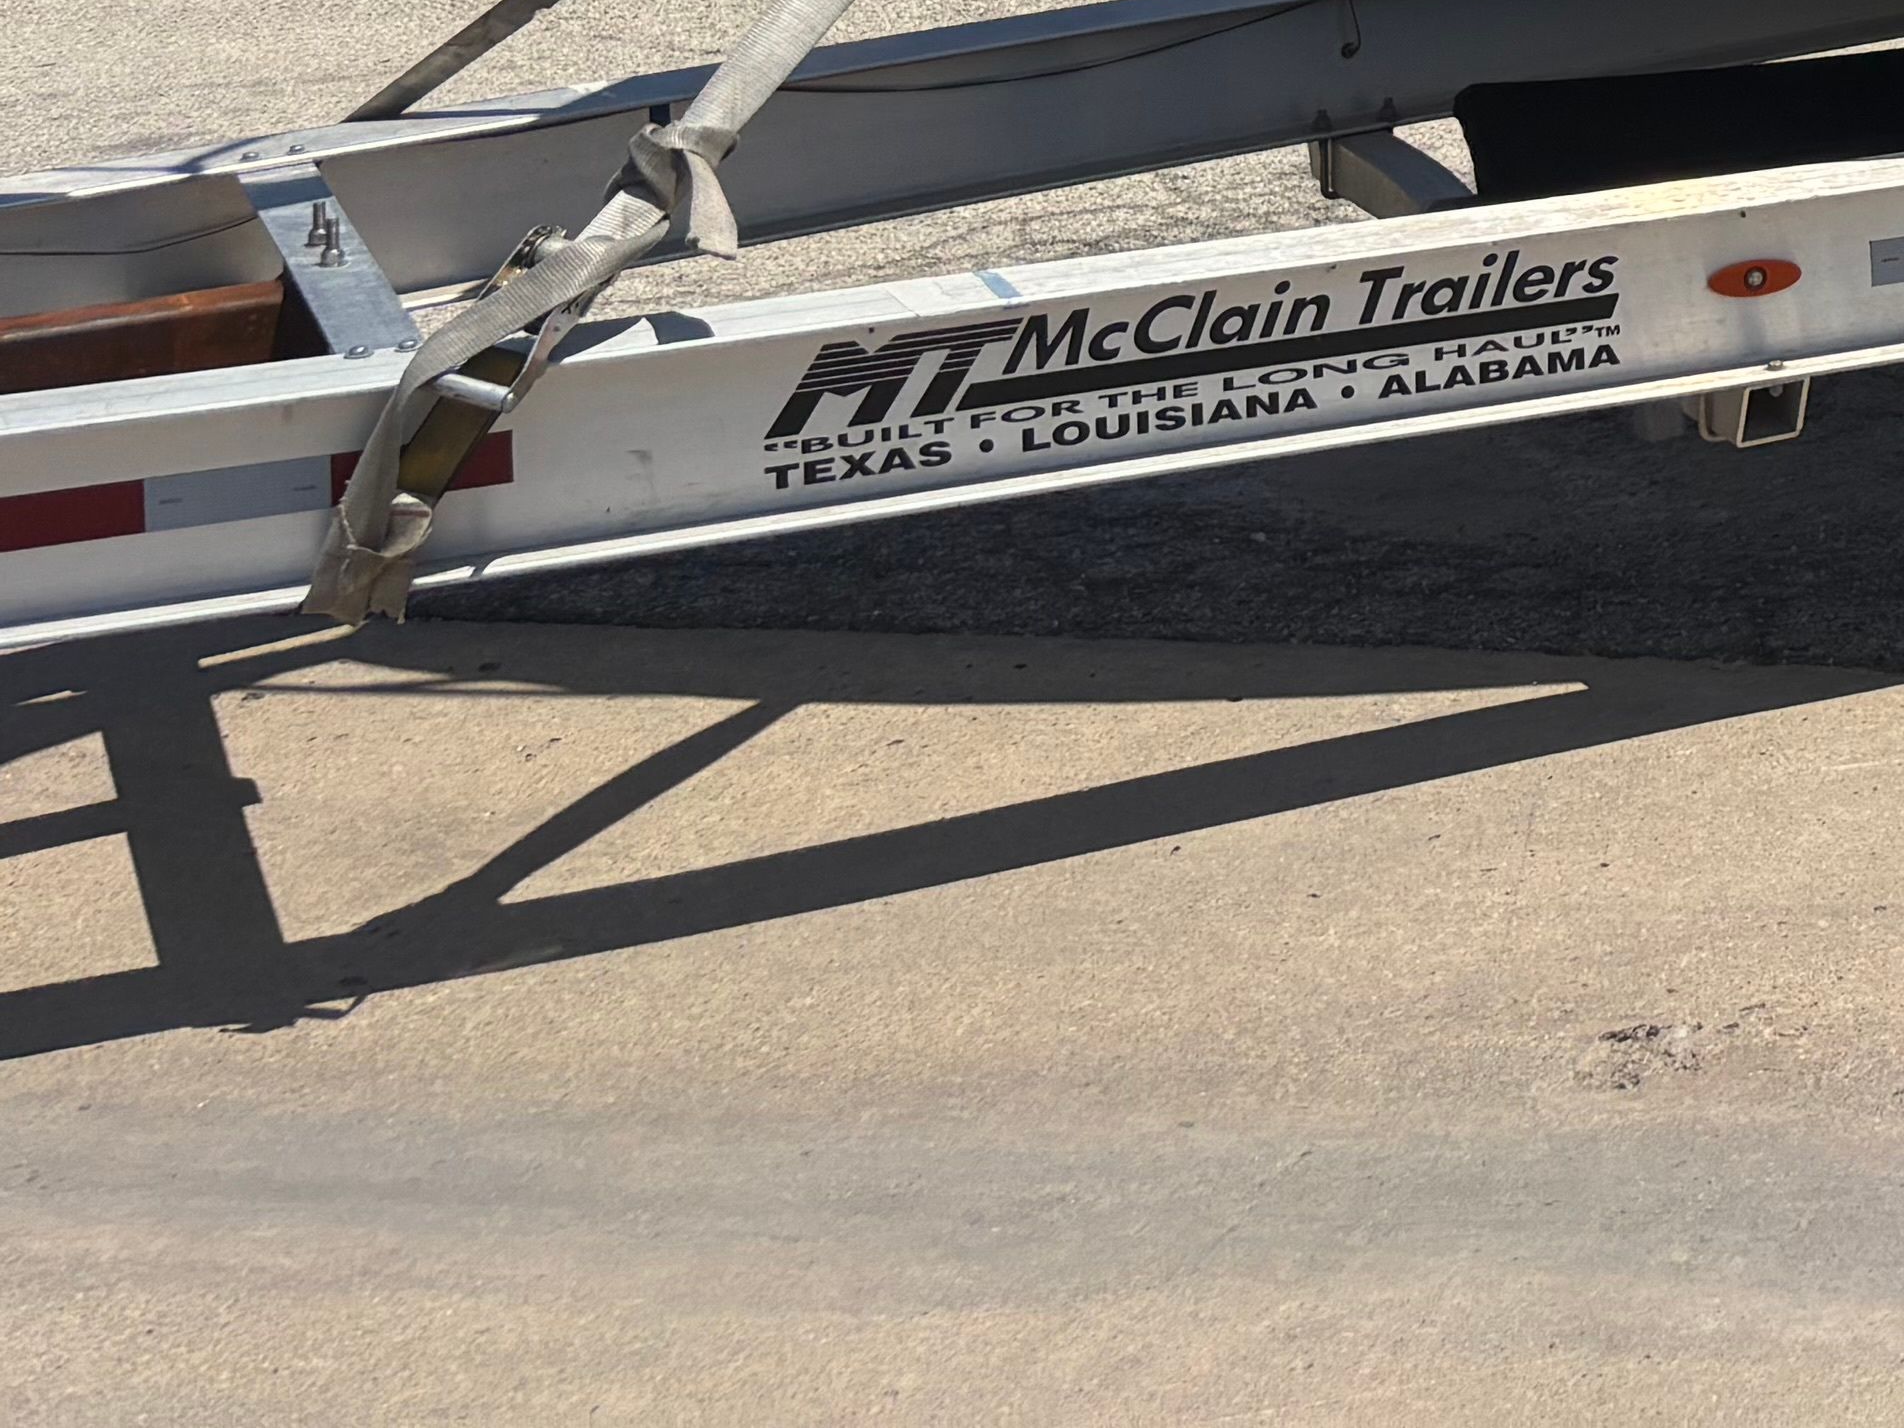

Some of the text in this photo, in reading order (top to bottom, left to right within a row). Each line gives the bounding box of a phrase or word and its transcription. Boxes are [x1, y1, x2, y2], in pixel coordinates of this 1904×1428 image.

[1002, 280, 1331, 375] McClain
[1358, 250, 1620, 325] Trailers
[765, 343, 1620, 490] TEXAS LOUISIANA ALABAMA
[969, 399, 1084, 429] FOR
[1097, 381, 1197, 409] THE
[1223, 353, 1410, 392] LONG
